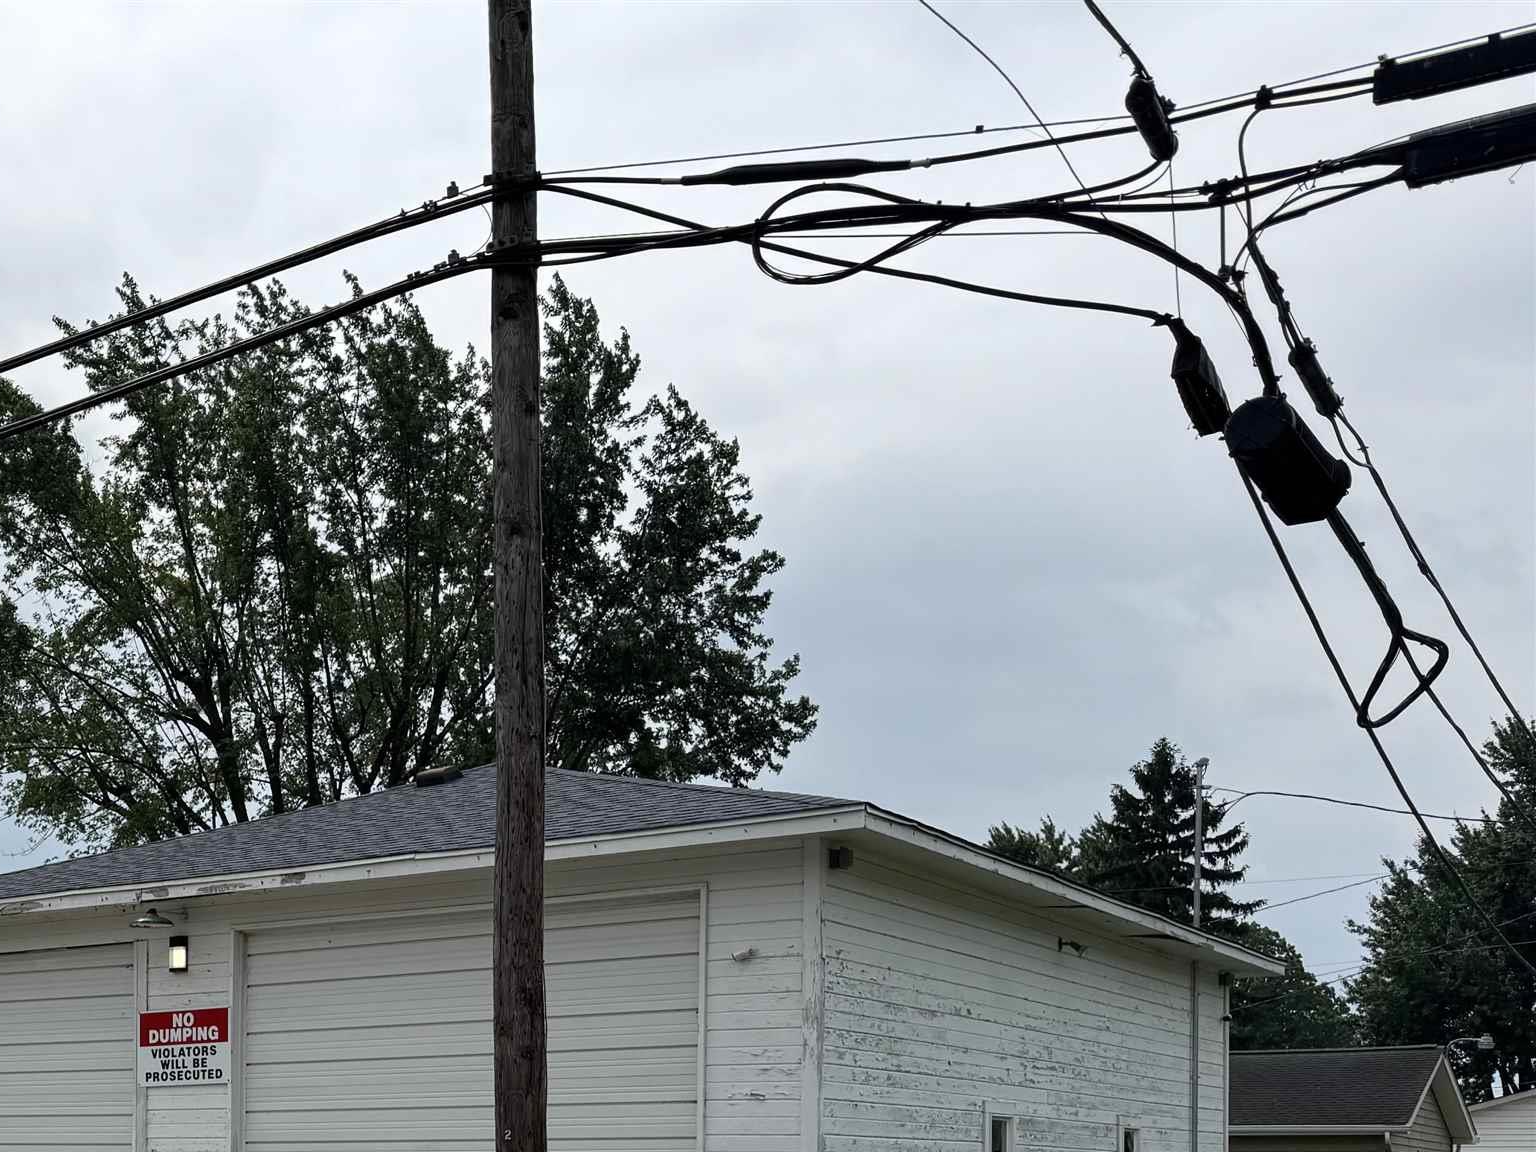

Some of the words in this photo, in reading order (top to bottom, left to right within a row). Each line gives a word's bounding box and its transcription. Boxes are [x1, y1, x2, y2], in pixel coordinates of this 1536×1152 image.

[172, 1012, 195, 1028] NO
[148, 1025, 219, 1044] DUMPING
[151, 1045, 217, 1059] VIOLATORS
[160, 1059, 188, 1070] WILL
[192, 1058, 208, 1069] BE
[145, 1068, 223, 1082] PROSECUTED
[504, 1129, 512, 1140] 2
